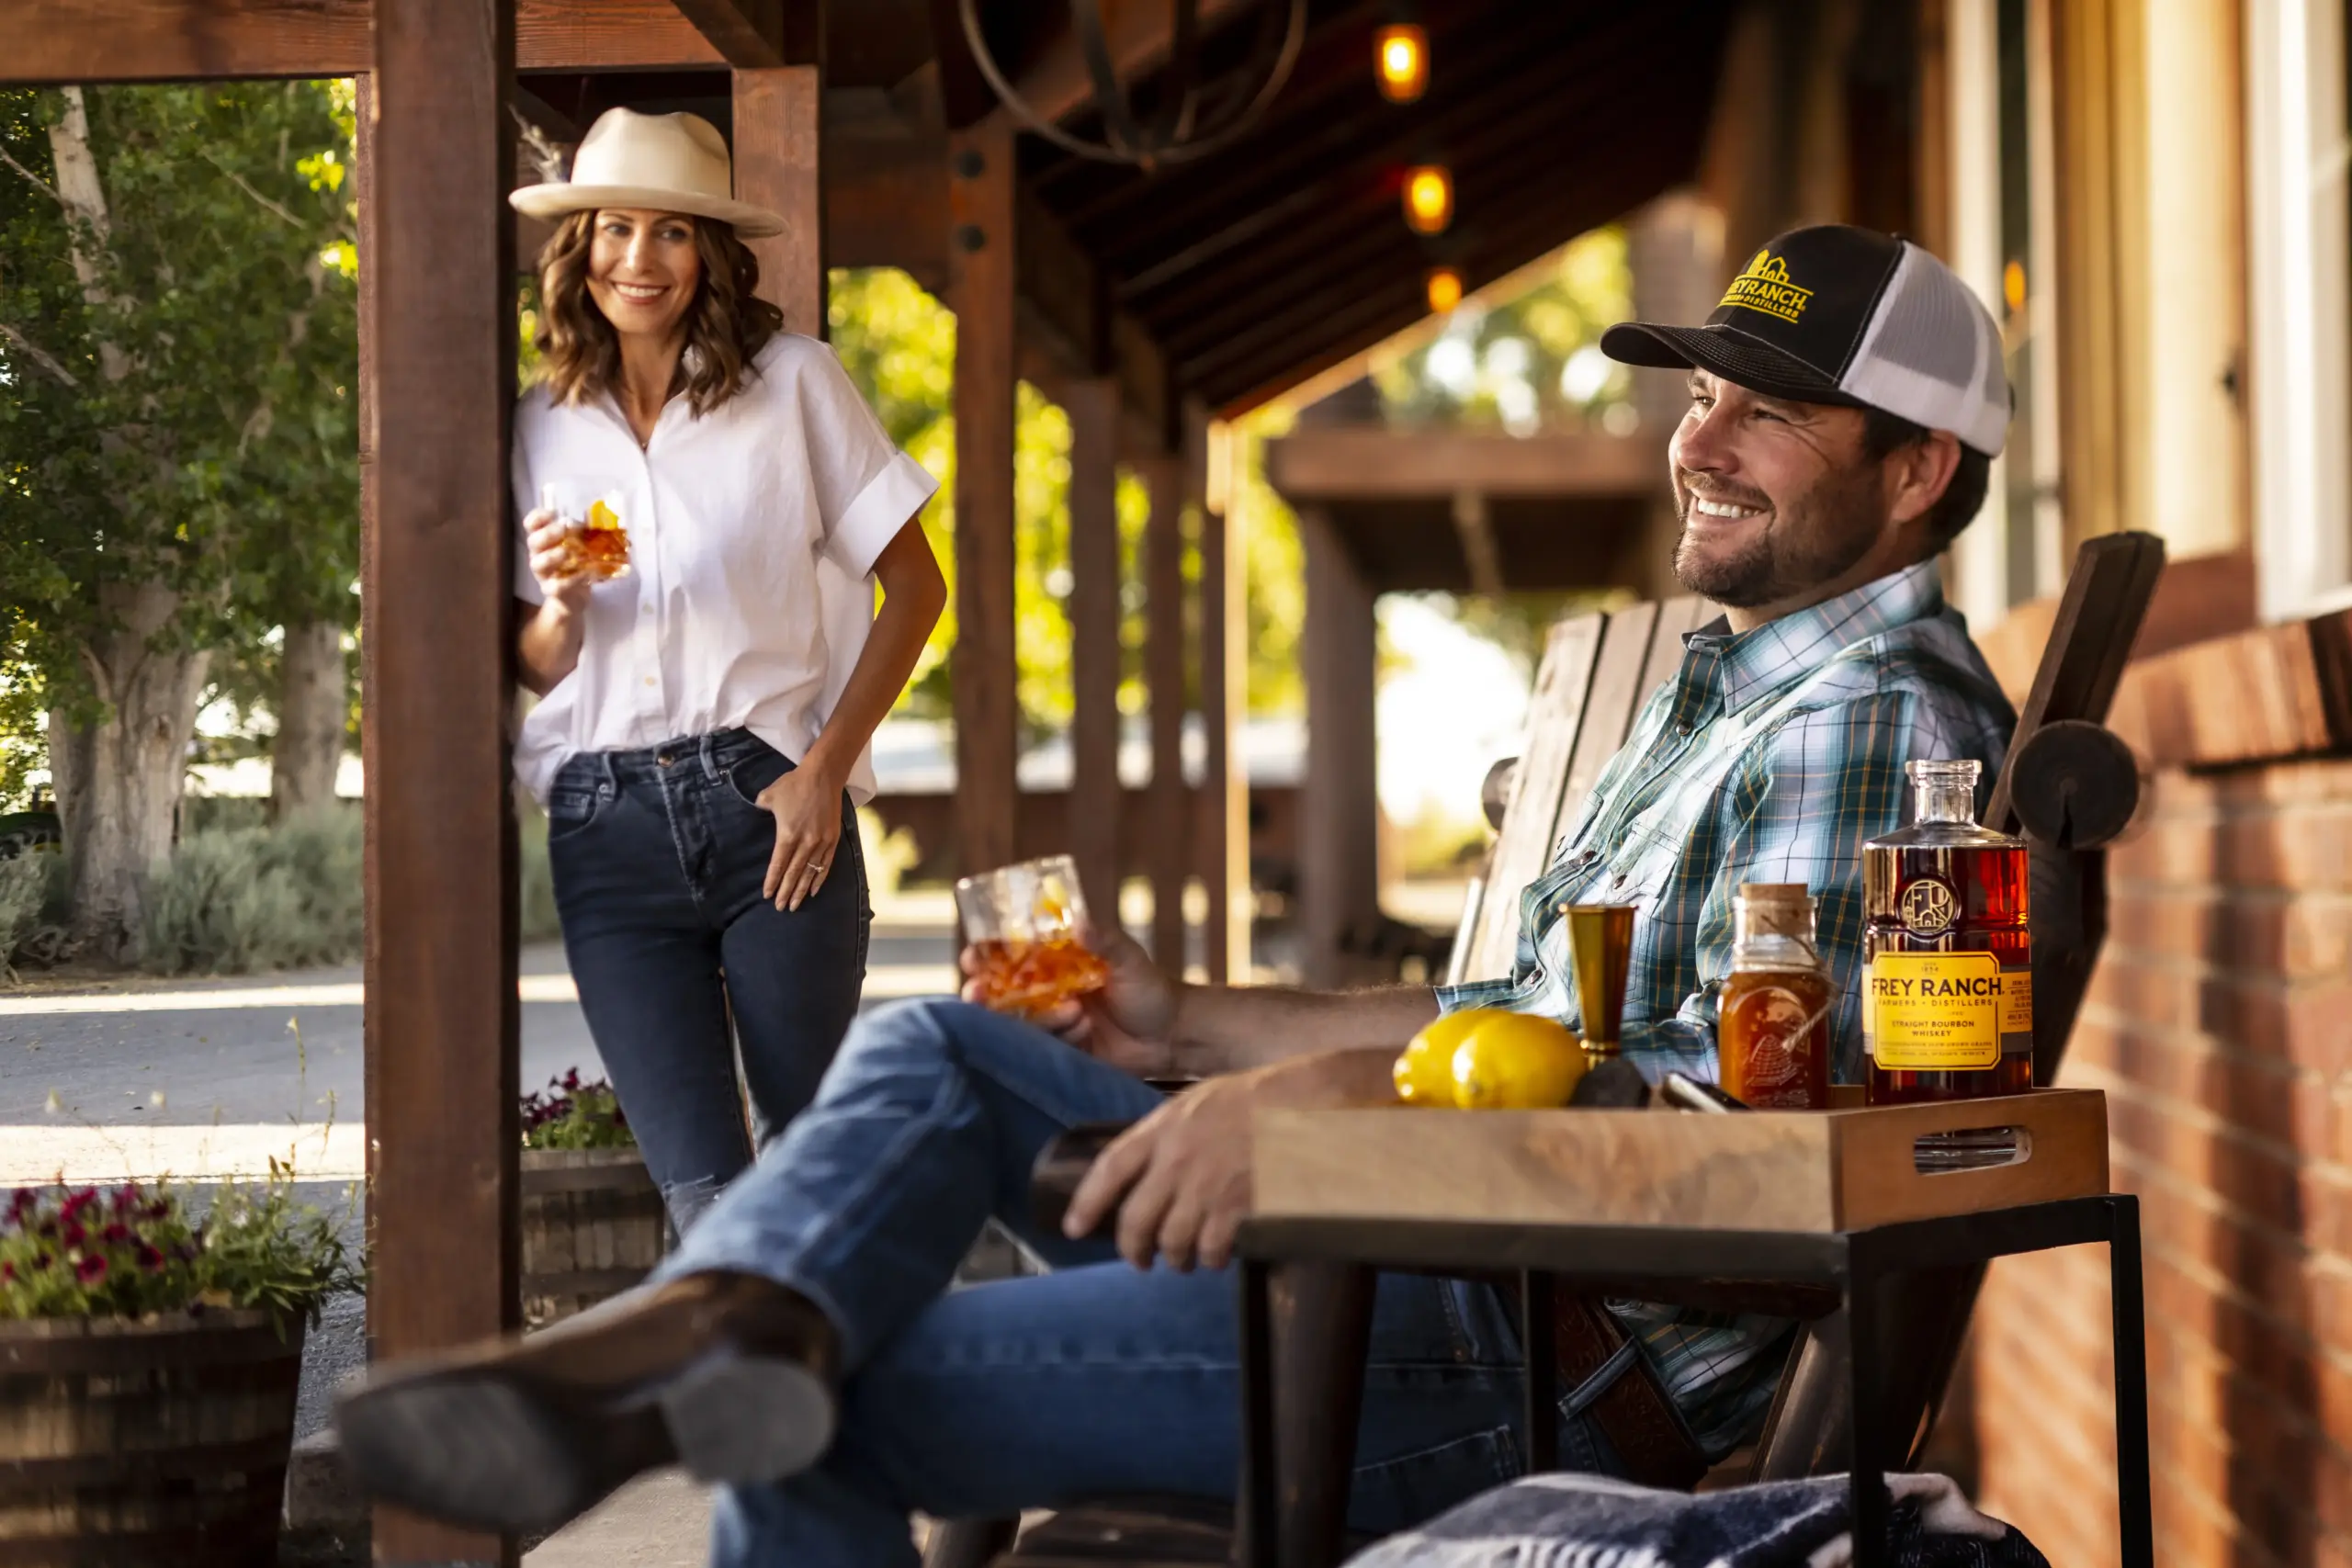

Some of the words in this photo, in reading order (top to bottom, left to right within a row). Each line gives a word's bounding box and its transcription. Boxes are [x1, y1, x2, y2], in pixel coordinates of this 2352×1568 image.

[1871, 977, 1914, 997] FREY
[1921, 977, 2002, 997] RANCH
[1931, 998, 1992, 1007] DISTILLERS
